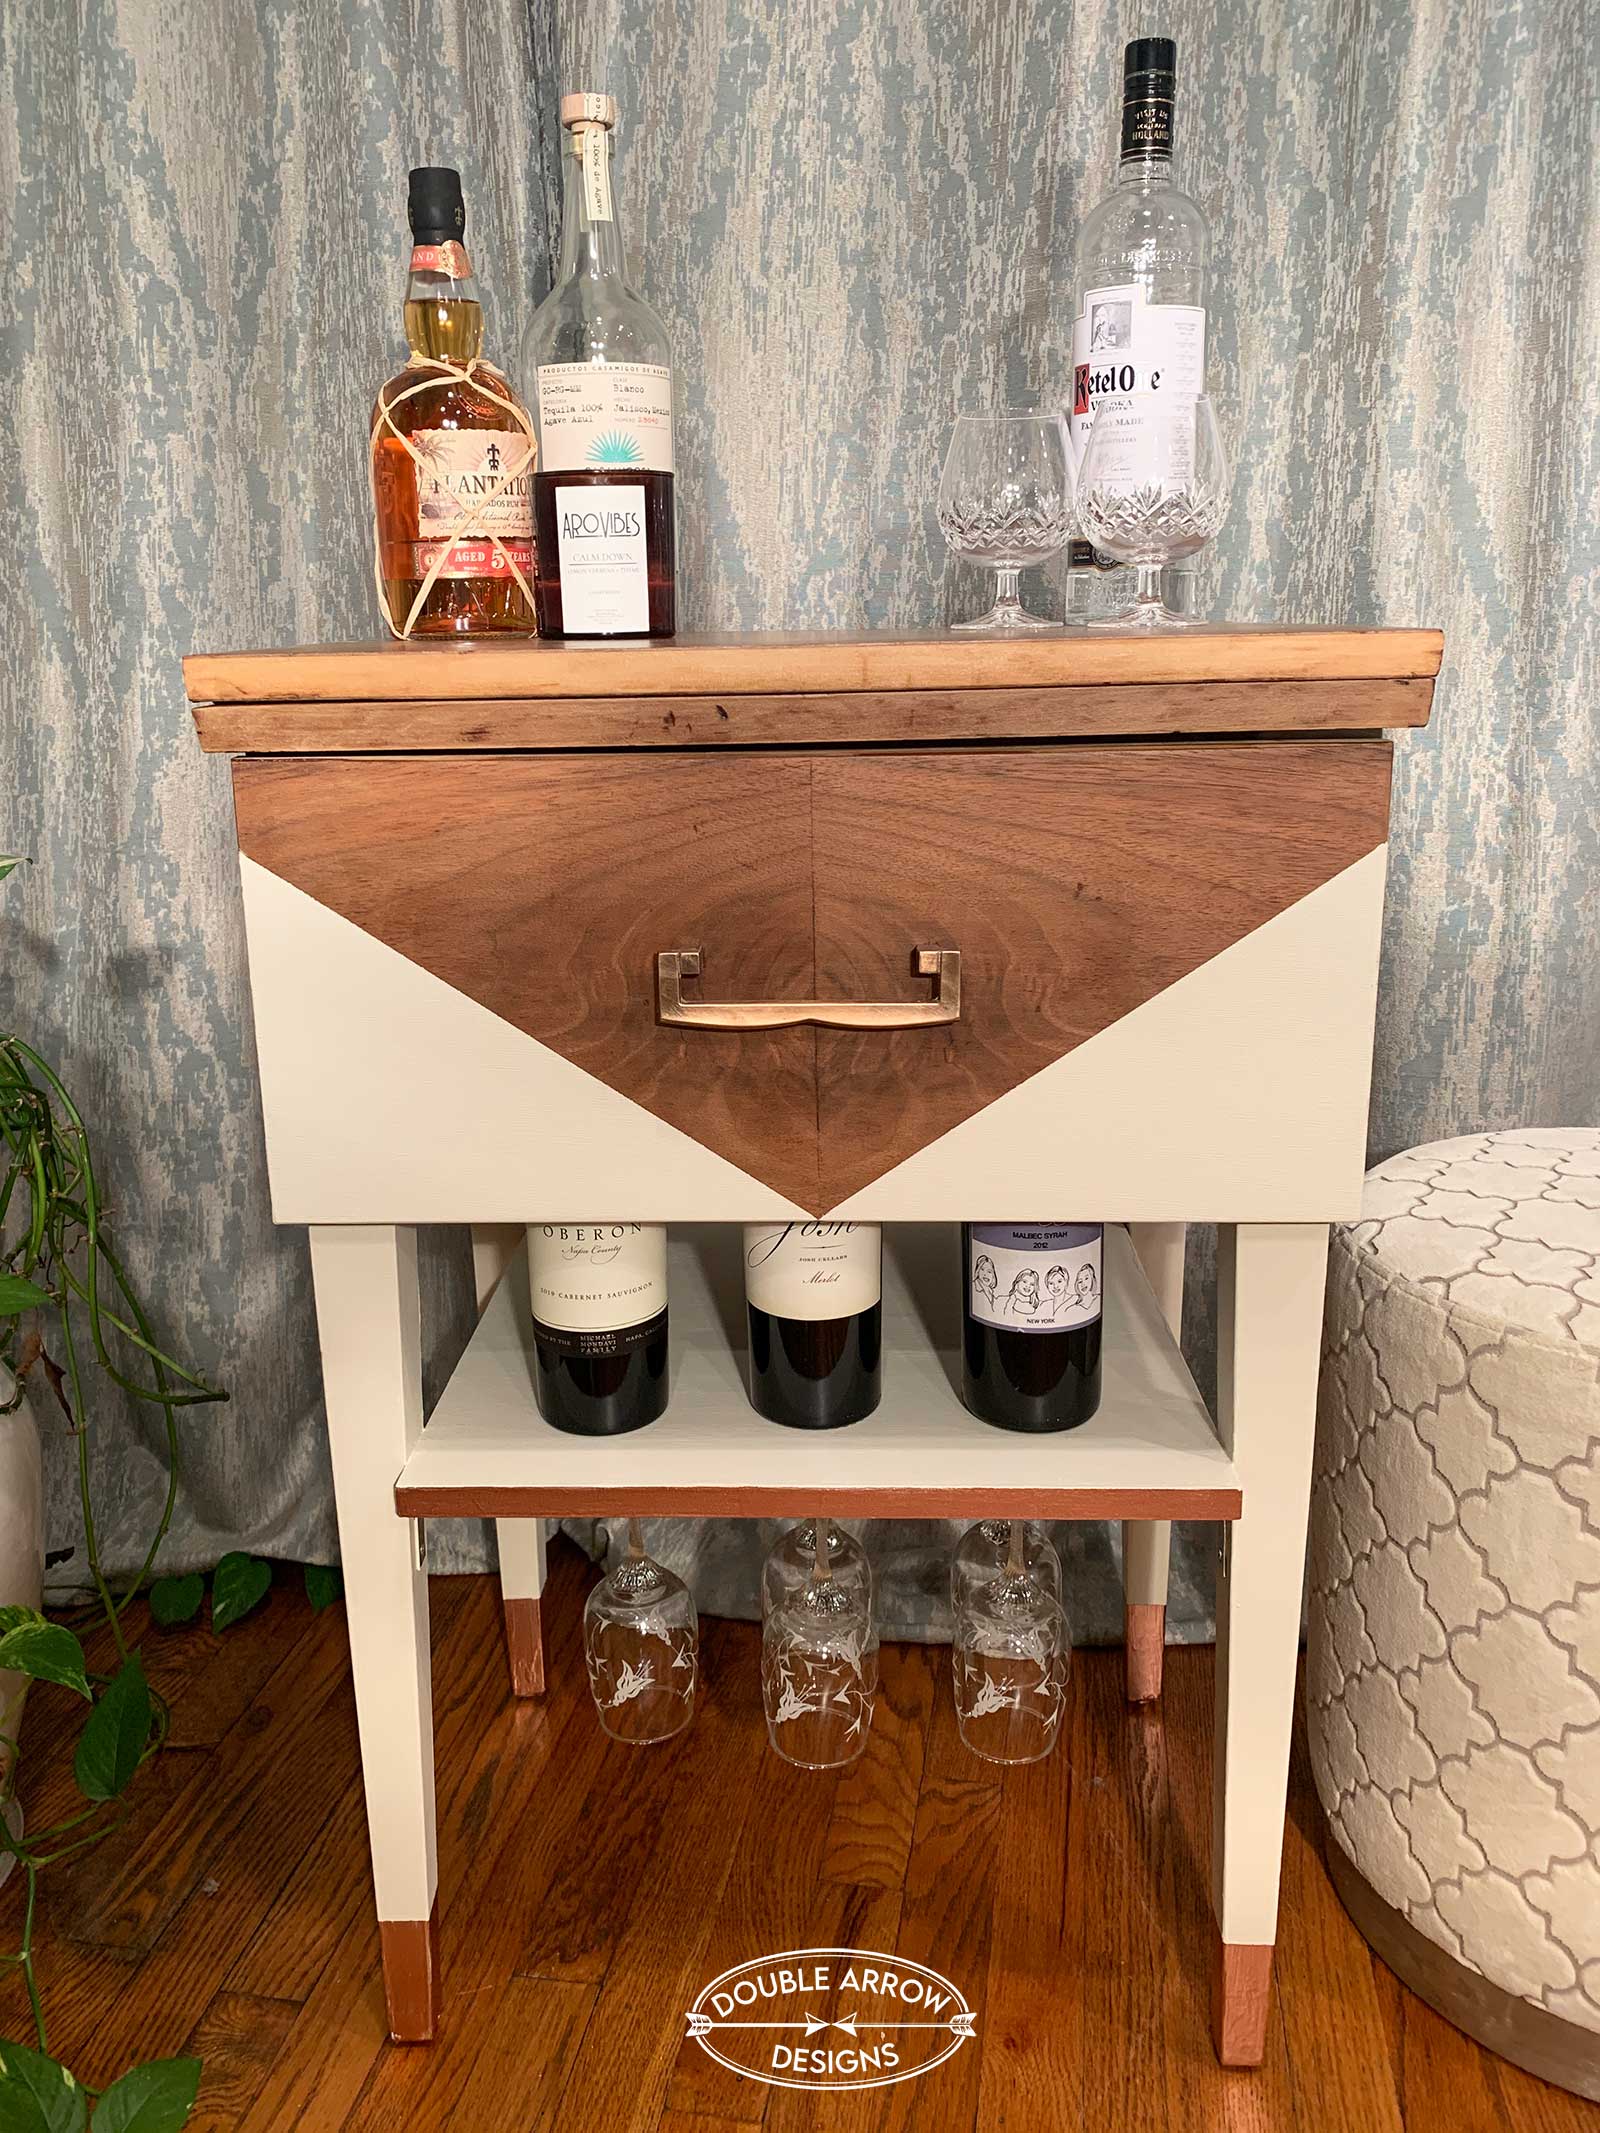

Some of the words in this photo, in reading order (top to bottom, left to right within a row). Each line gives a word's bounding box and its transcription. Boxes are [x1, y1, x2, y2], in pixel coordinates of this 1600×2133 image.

[1132, 130, 1169, 140] HOLLAND
[543, 366, 588, 375] PRODUCTOS
[592, 365, 639, 373] CASAMIGOS
[613, 383, 645, 394] Blanco
[1074, 366, 1117, 410] Ketel
[1119, 364, 1161, 392] Oe
[543, 405, 576, 416] Tequila
[581, 403, 604, 413] 100%
[613, 403, 651, 415] Jalisco,
[543, 417, 567, 427] Agave
[571, 415, 594, 424] Azul
[433, 474, 529, 496] PLANTATIO
[563, 512, 641, 539] AROVIBES
[454, 551, 486, 563] AGED
[490, 548, 506, 569] 5
[572, 552, 599, 562] CALM
[601, 552, 633, 561] DOWN
[542, 1222, 642, 1241] OBERON
[1013, 1231, 1043, 1240] MALBEC
[1044, 1231, 1068, 1240] SYRAH
[561, 1244, 589, 1261] Napa
[590, 1243, 622, 1265] County
[802, 1270, 841, 1284] Merlot
[558, 1292, 603, 1301] CABERNET
[607, 1280, 653, 1299] SAUVIGNON
[580, 1333, 617, 1341] MICHAEL
